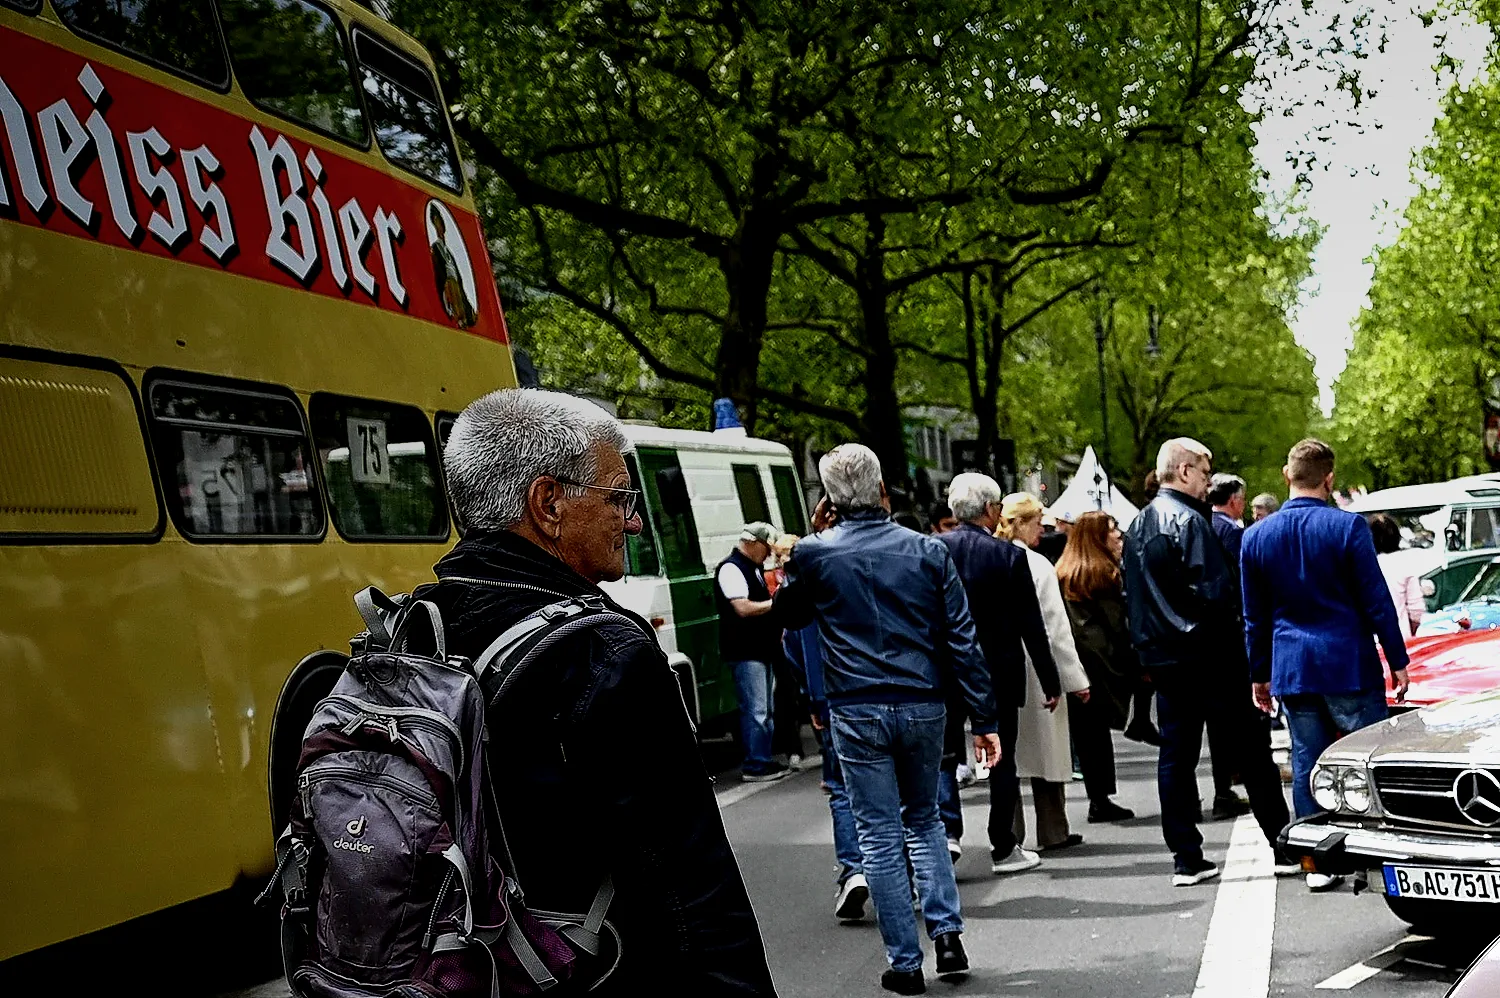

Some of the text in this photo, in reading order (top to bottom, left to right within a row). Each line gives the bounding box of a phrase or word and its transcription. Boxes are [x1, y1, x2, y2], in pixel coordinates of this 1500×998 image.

[250, 124, 406, 305] Bier
[357, 423, 382, 476] 75
[333, 837, 375, 854] deuter
[1397, 870, 1410, 893] B
